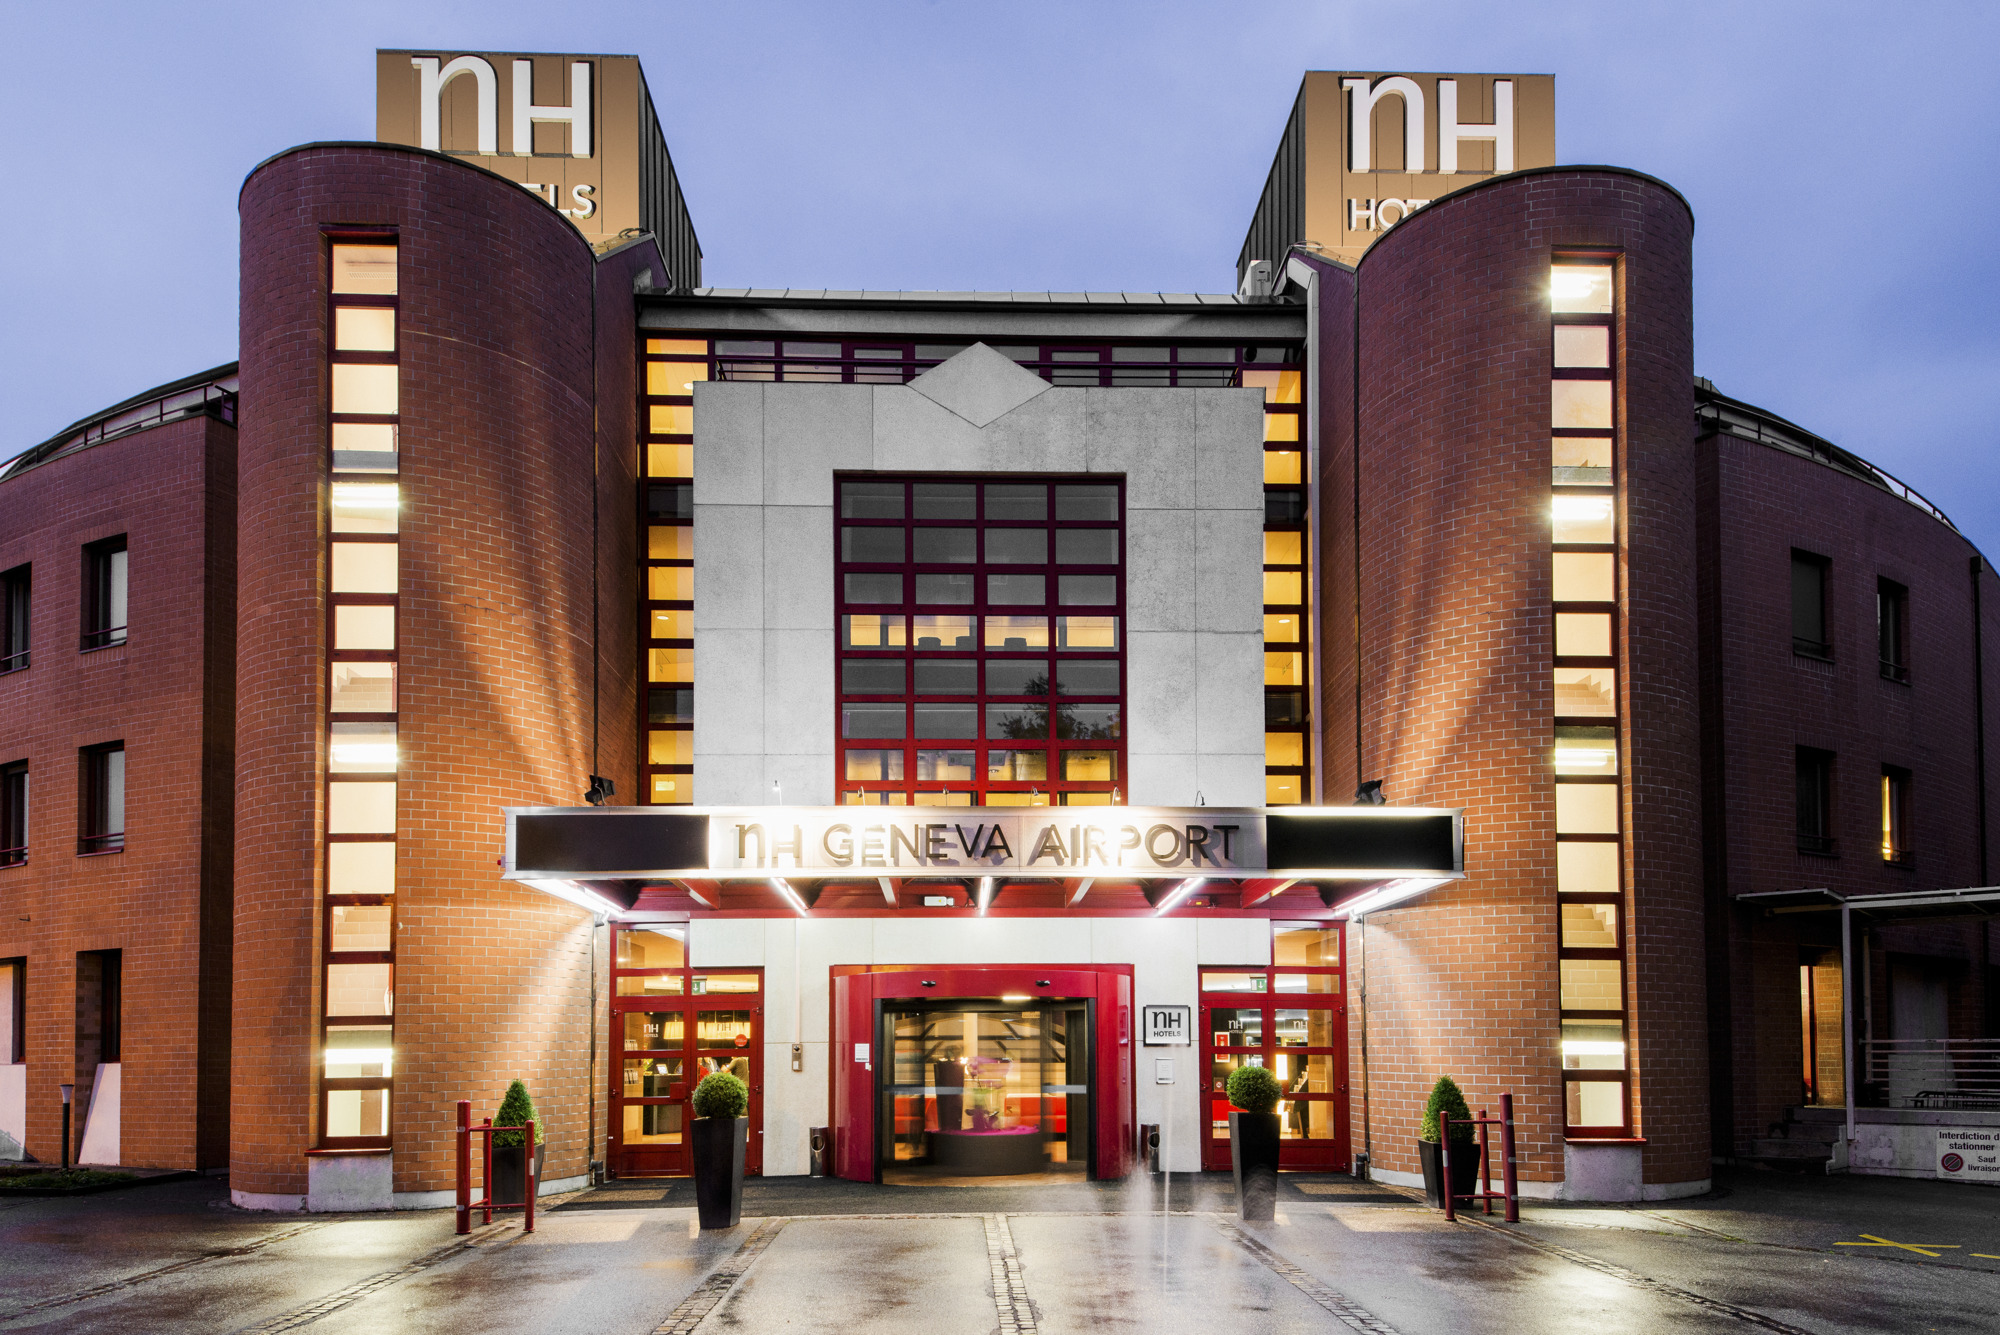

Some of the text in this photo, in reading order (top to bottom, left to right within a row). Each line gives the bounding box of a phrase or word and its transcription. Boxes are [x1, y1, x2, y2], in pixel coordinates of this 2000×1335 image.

[1349, 198, 1434, 232] HOT
[823, 823, 1014, 862] GENEVA
[1036, 824, 1240, 861] AIRPORT
[1939, 1131, 1991, 1141] Interdiction
[1949, 1142, 1995, 1151] stationner
[1978, 1155, 1996, 1163] Sauf
